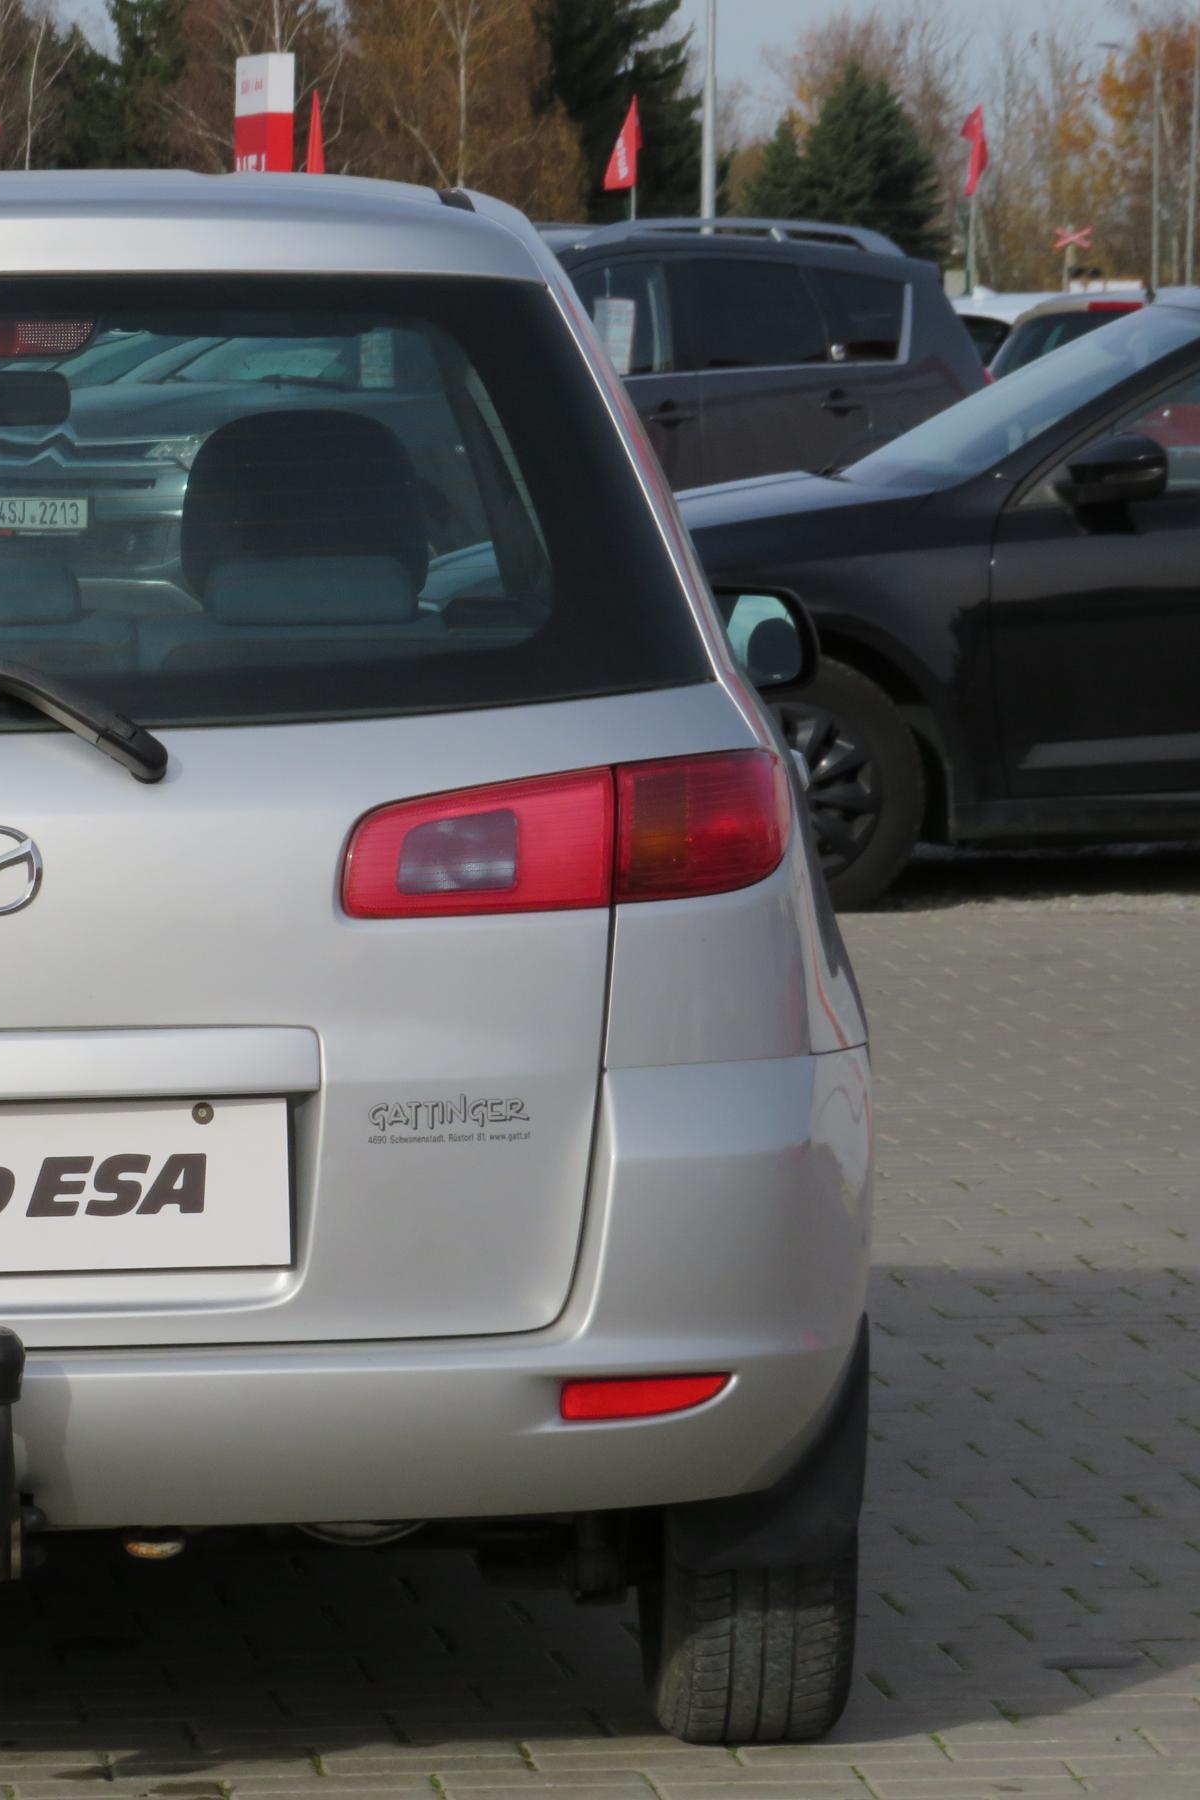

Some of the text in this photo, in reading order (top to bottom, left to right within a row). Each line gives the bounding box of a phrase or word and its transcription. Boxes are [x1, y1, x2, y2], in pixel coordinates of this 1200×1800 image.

[0, 501, 79, 525] 4SJ 2213
[368, 1094, 530, 1131] GATTINGER
[367, 1136, 387, 1145] 4690
[25, 1152, 207, 1218] ESA
